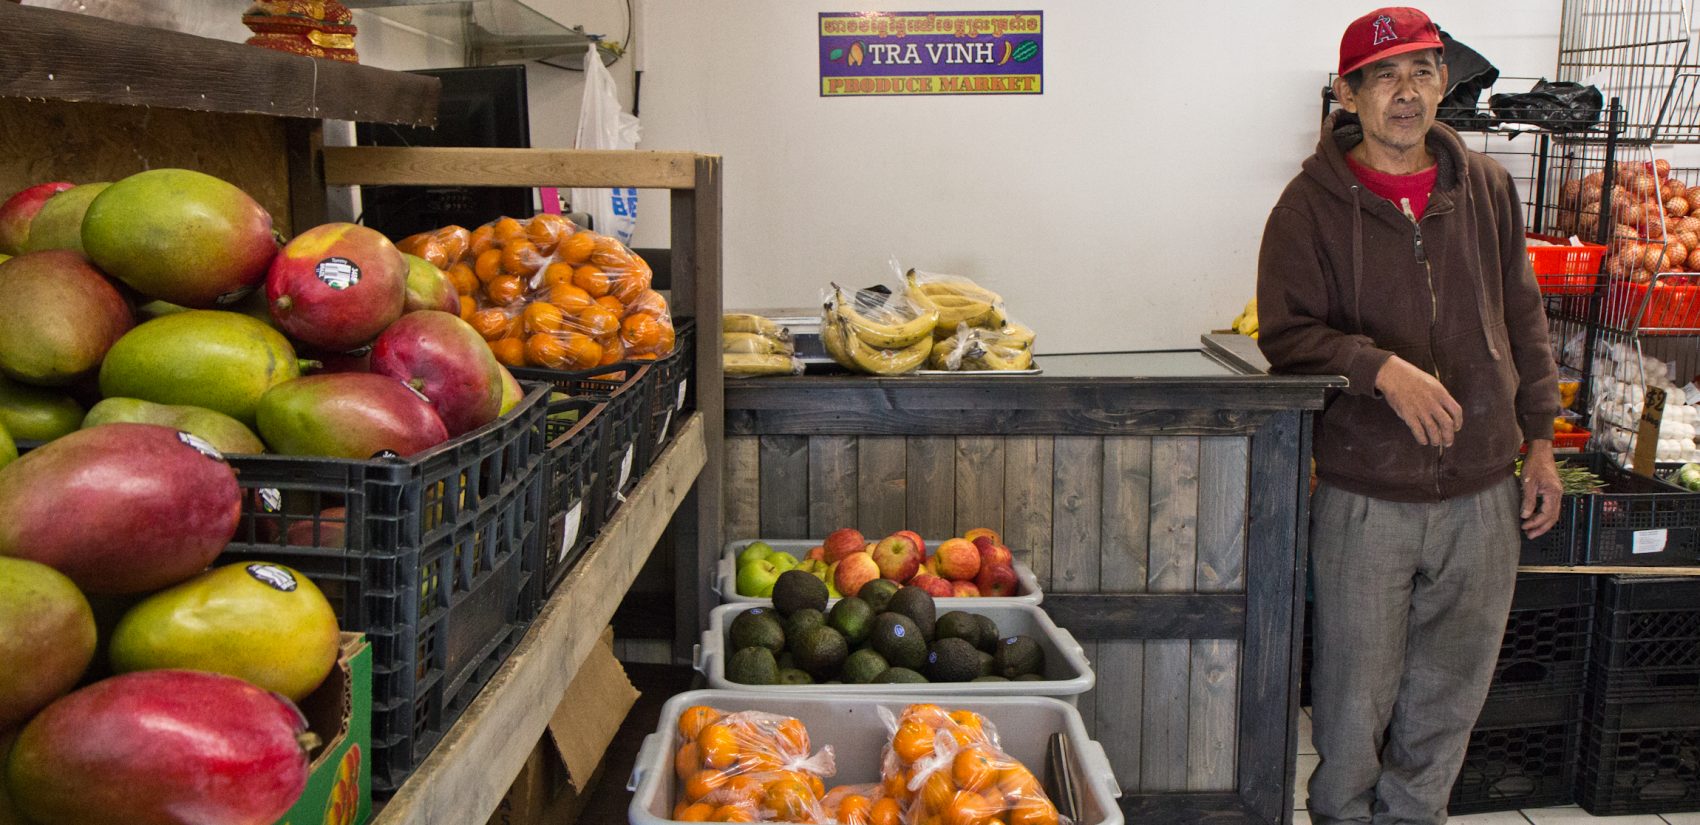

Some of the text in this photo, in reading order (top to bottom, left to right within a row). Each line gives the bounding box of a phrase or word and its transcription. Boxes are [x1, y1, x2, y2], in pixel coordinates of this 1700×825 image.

[1373, 15, 1398, 45] A
[868, 42, 994, 65] TRA VINH
[828, 76, 1036, 94] PRODUCE MARKET
[1645, 389, 1665, 411] $2
